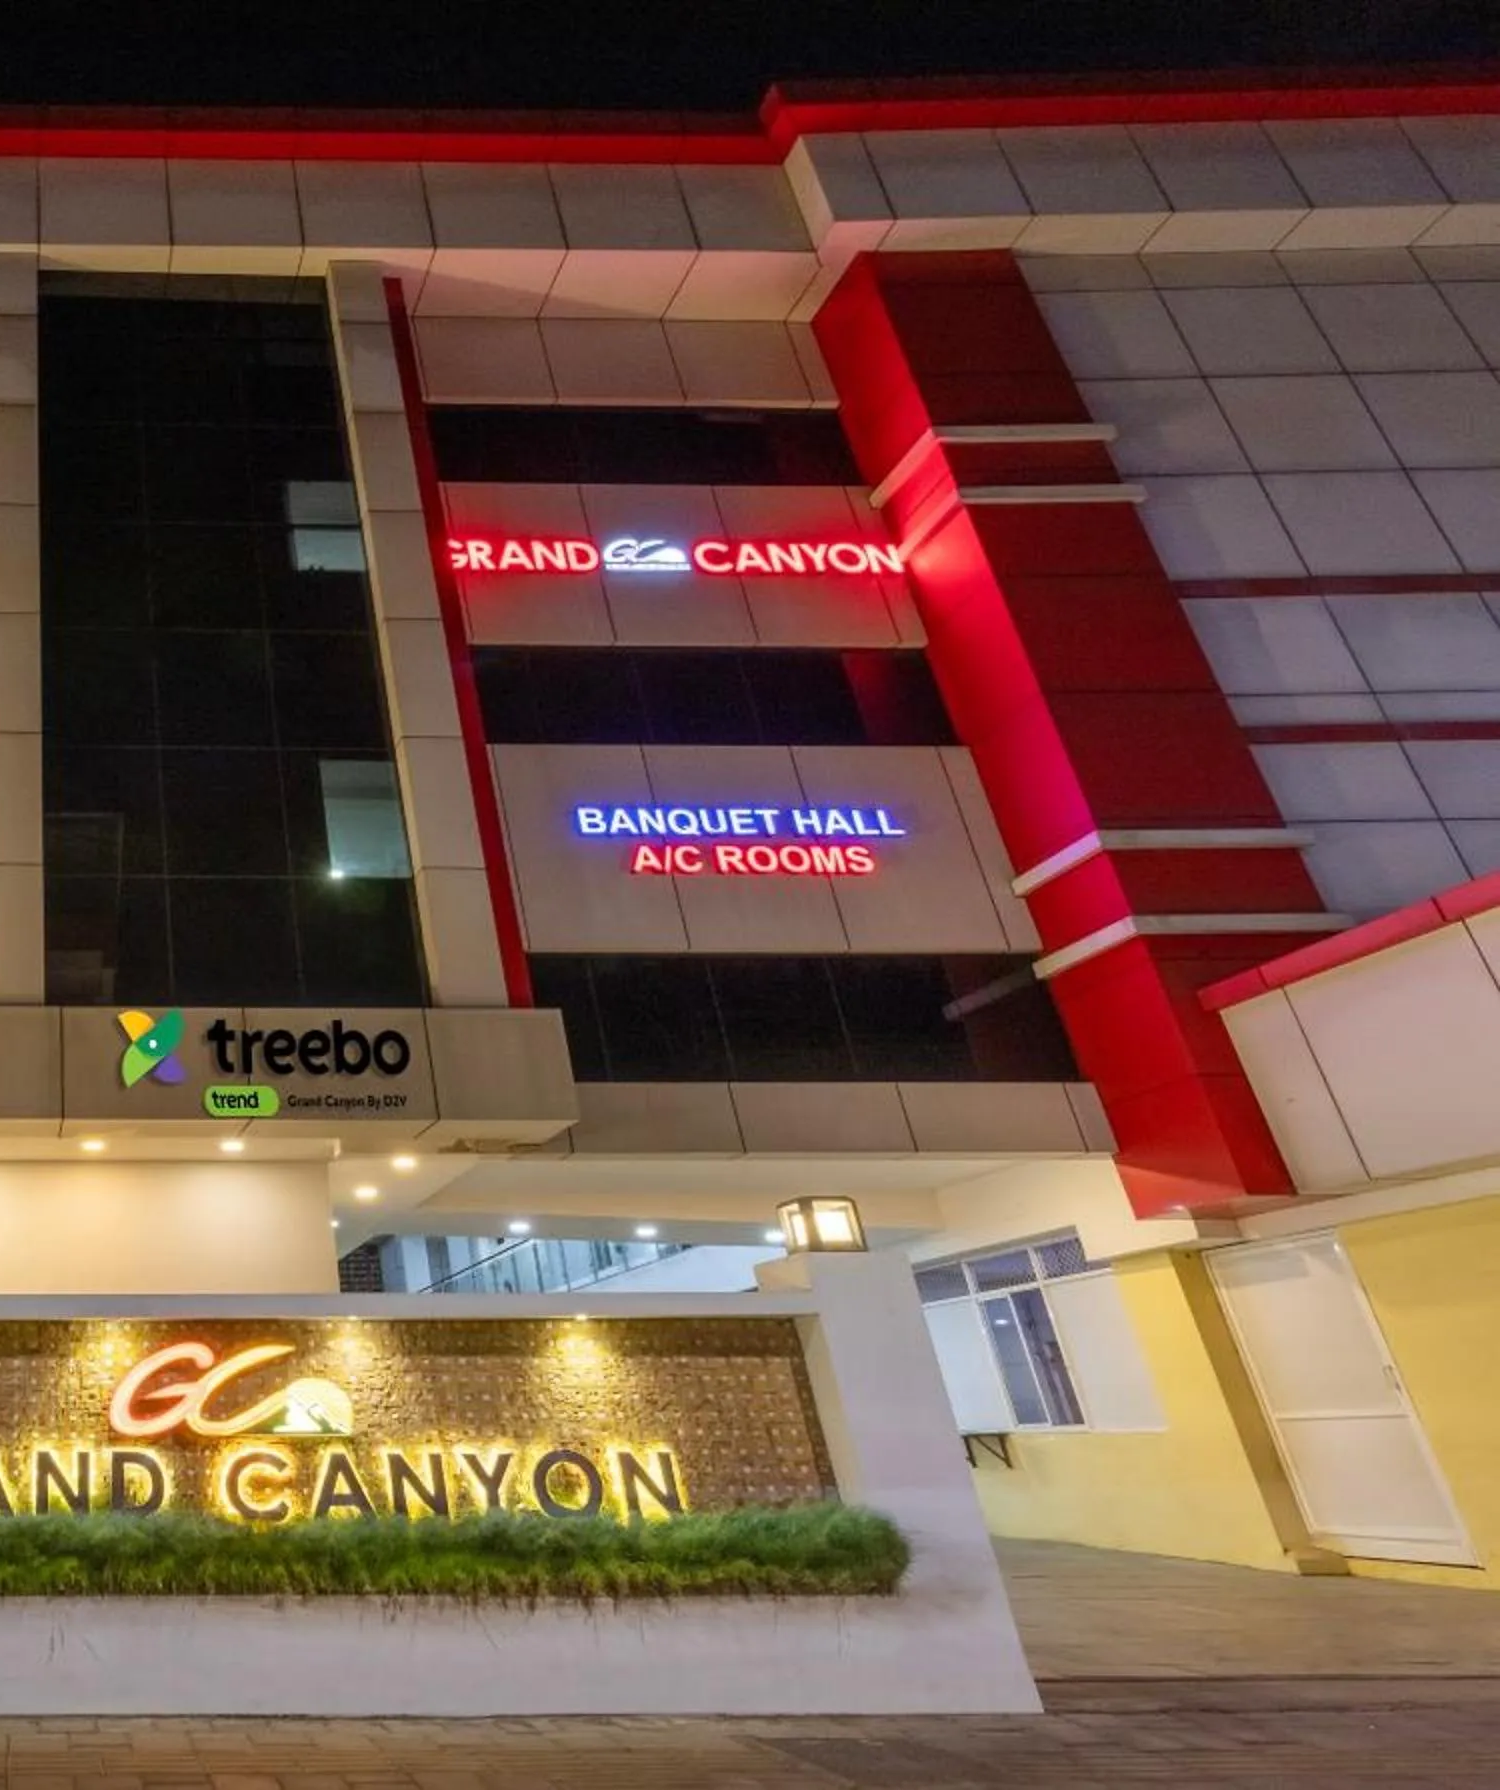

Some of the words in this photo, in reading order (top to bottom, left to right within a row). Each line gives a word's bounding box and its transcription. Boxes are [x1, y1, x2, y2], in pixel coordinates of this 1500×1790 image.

[694, 541, 905, 574] CANYON
[578, 808, 779, 836] BANQUET
[794, 809, 906, 835] HALL
[633, 845, 702, 873] A/C
[715, 845, 875, 873] ROOMS
[207, 1019, 410, 1075] treebo
[212, 1091, 259, 1109] trend
[325, 1095, 365, 1113] Canyon
[367, 1095, 380, 1110] By
[225, 1449, 686, 1520] CANYON
